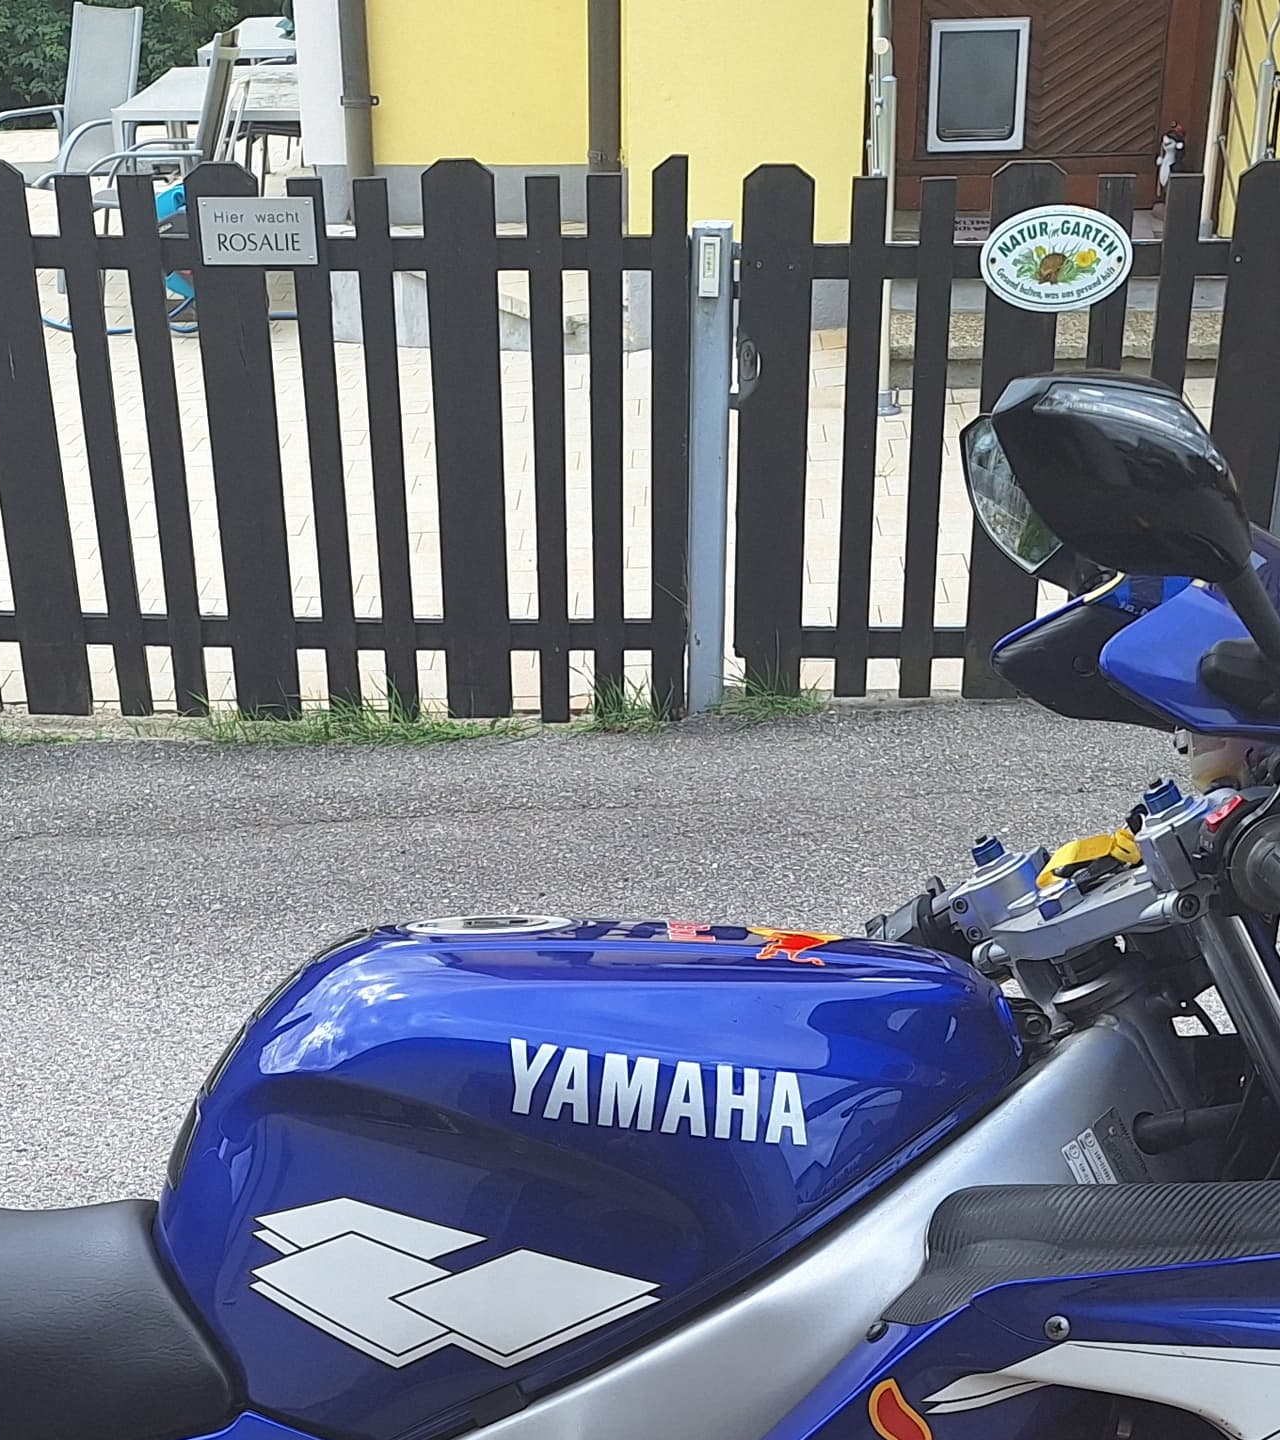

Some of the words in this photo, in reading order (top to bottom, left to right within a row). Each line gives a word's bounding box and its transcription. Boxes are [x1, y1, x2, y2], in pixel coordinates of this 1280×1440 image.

[213, 211, 245, 224] Hier
[255, 211, 300, 224] wacht
[217, 232, 301, 252] ROSALIE
[997, 221, 1049, 258] NATUR
[1061, 219, 1119, 257] GARTEN
[996, 267, 1020, 291] Gesund
[508, 1036, 808, 1146] YAMAHA
